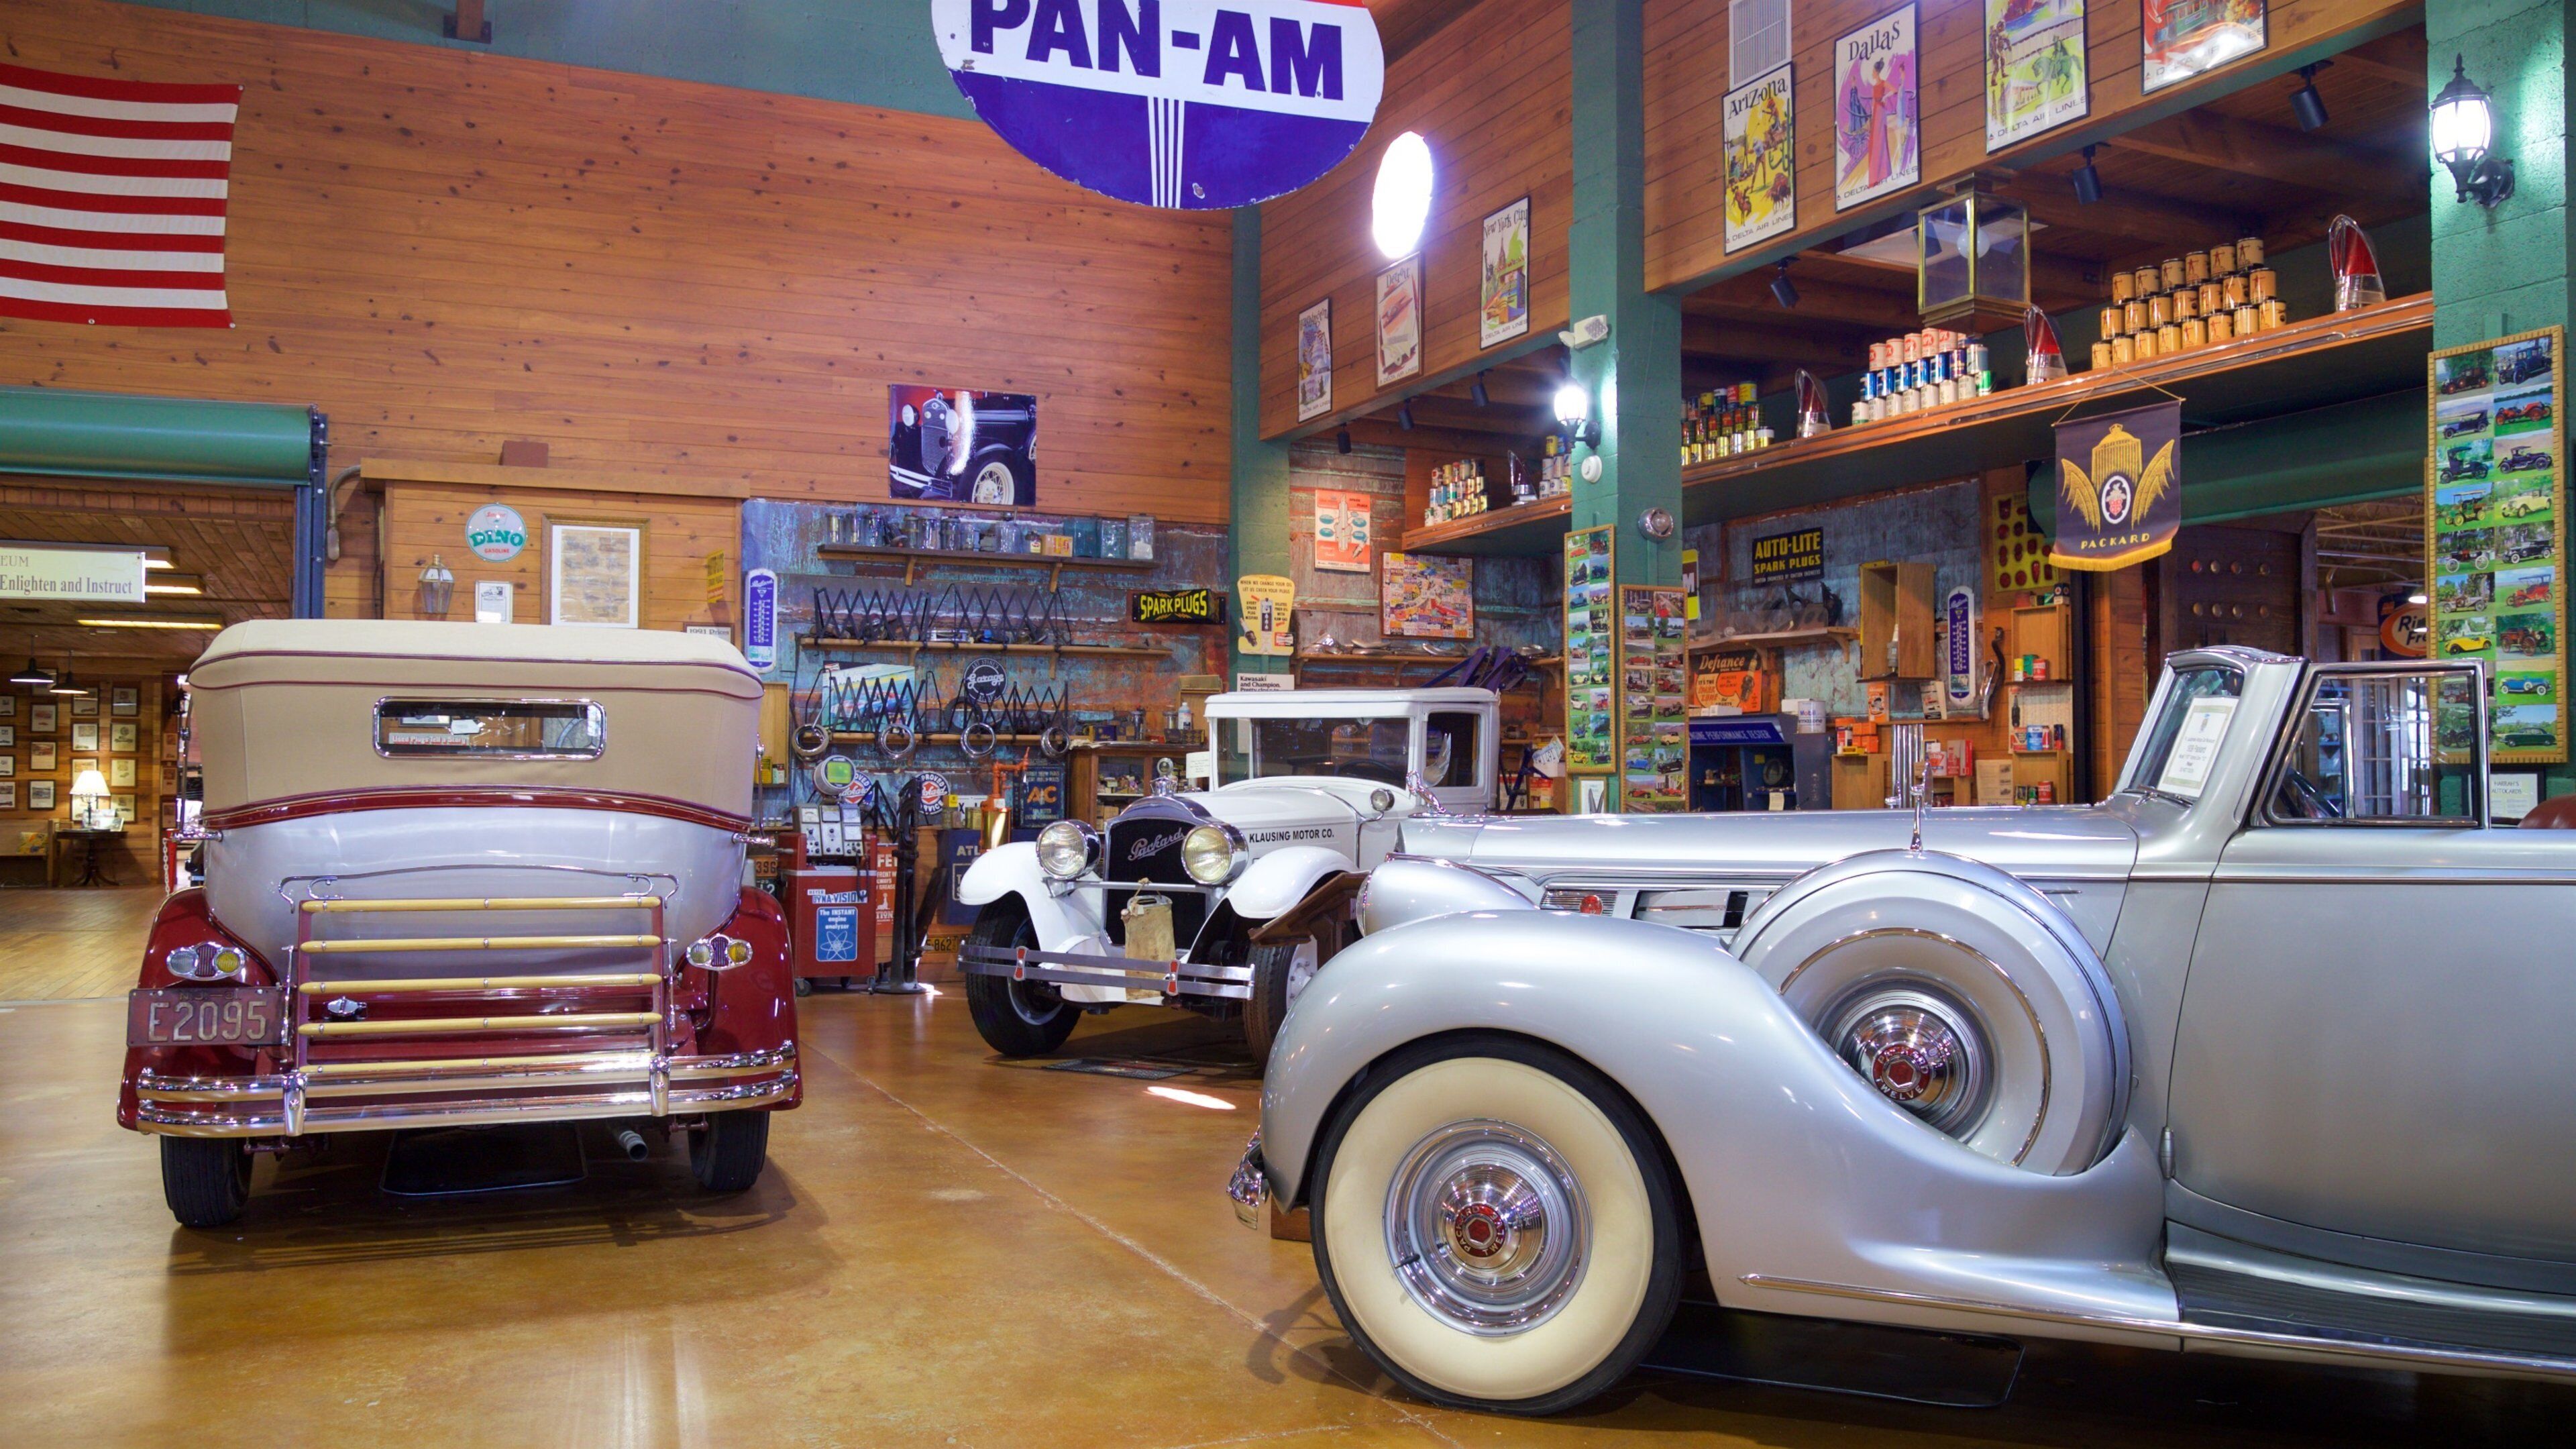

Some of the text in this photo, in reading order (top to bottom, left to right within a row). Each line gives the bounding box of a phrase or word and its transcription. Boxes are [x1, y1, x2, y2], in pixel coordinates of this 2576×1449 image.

[971, 0, 1344, 101] PAN-AM
[1848, 20, 1900, 61] Dallas
[2055, 96, 2086, 114] LINES
[1843, 184, 1870, 199] DELTA
[1891, 166, 1919, 182] LINES
[1513, 207, 1528, 229] City
[1731, 211, 1794, 241] DELTA AIR LINES
[1485, 330, 1501, 341] DELTA
[470, 529, 524, 548] DINO
[1754, 531, 1821, 560] AUTO-LITE
[2081, 533, 2150, 549] PACKARD
[1754, 554, 1821, 575] SPARK PLUGS
[0, 575, 133, 596] Enlighten and Instruct
[1140, 590, 1207, 621] SPARK PLUGS
[1699, 655, 1746, 673] Defiance
[966, 673, 1004, 690] Garage
[1706, 730, 1749, 740] PERFORMANCE
[1747, 729, 1771, 739] TESTER
[1026, 785, 1057, 804] AC
[1128, 827, 1187, 861] Packard
[1249, 828, 1335, 844] KLAUSING MOTOR CO.
[148, 1001, 268, 1042] E2095
[1875, 1075, 1924, 1100] TWELVE
[1455, 1205, 1480, 1252] PACKARD
[1482, 1211, 1505, 1256] TWELVE
